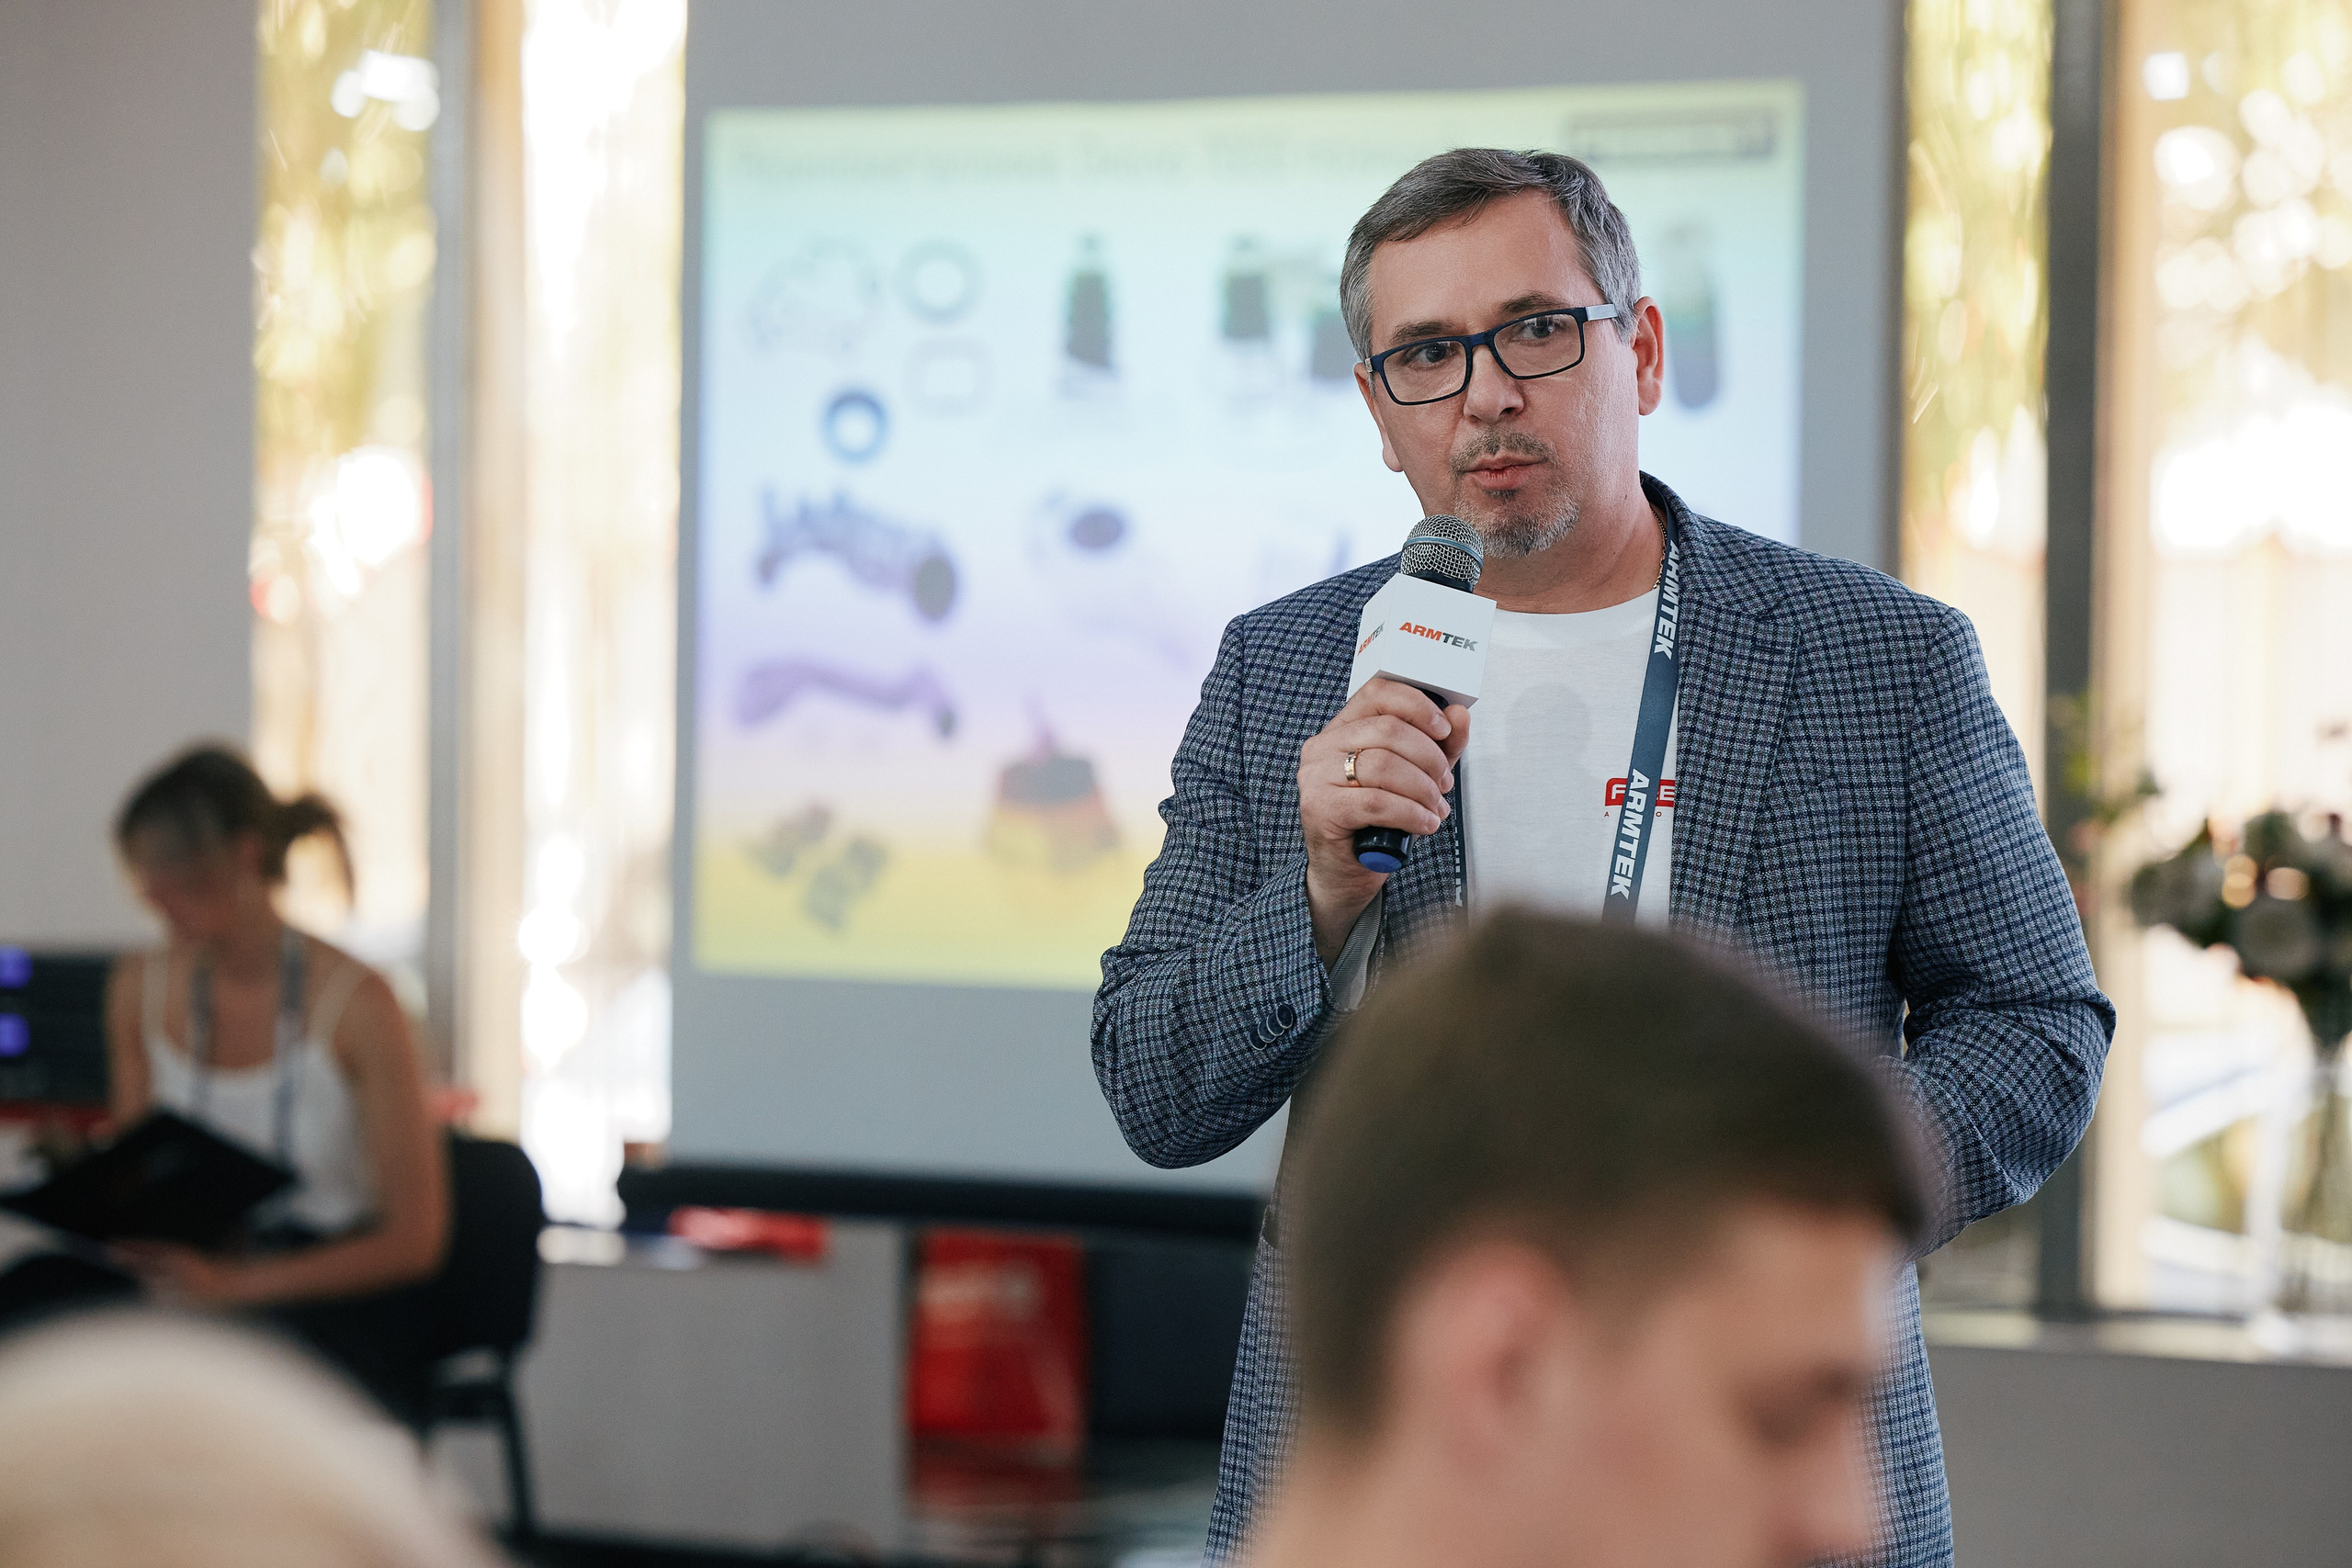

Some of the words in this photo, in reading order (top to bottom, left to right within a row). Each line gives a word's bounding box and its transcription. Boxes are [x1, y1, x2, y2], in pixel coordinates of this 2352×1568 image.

[1398, 621, 1479, 652] ARMTEK
[1654, 539, 1680, 660] ARMTEK
[1610, 768, 1650, 900] ARMTEK
